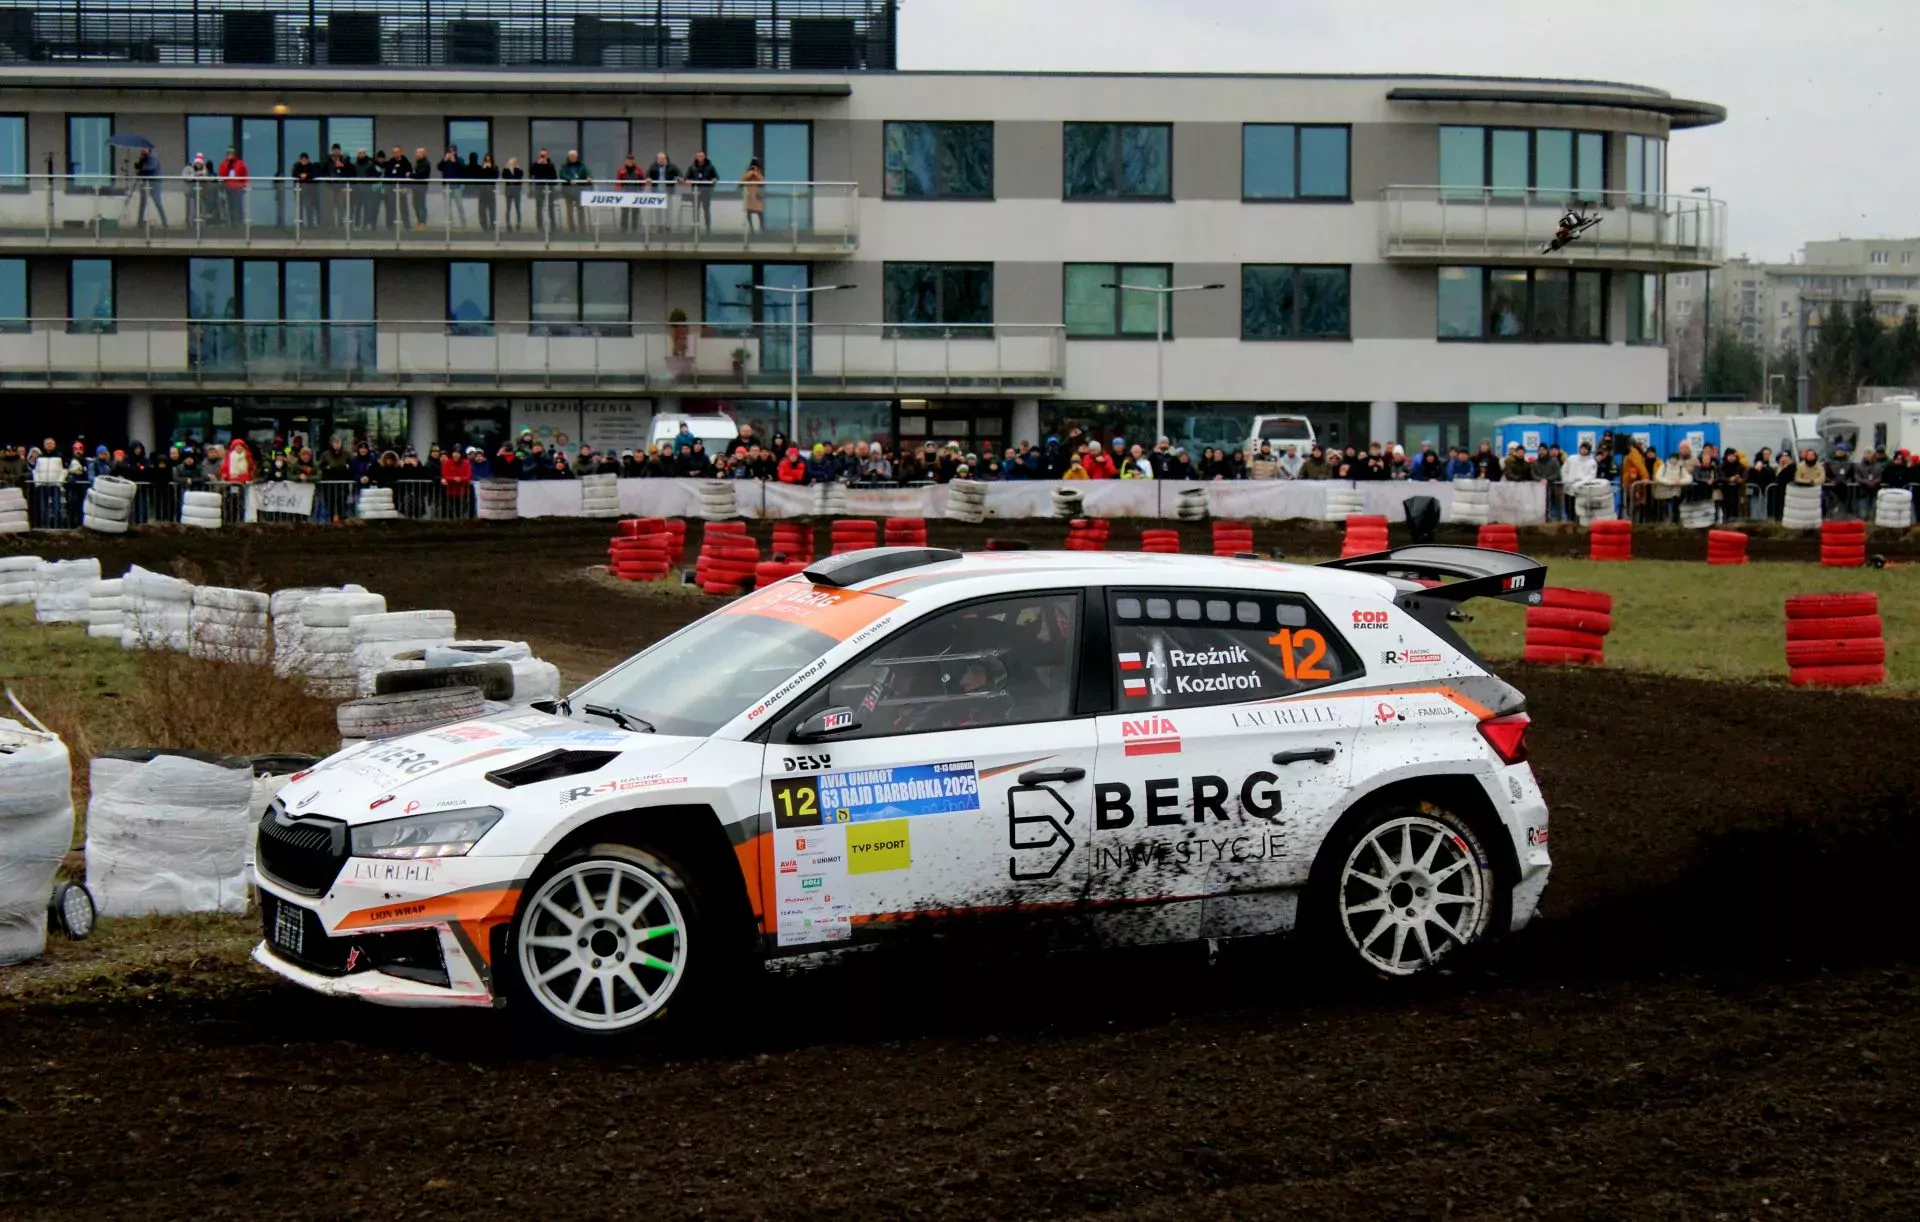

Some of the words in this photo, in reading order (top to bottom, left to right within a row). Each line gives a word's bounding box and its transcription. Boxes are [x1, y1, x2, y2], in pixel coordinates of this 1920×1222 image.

[590, 195, 623, 204] JURY
[632, 196, 664, 205] JURY
[1352, 610, 1388, 624] top
[1145, 652, 1165, 669] A.
[1170, 645, 1250, 668] Rzeźnik
[1267, 628, 1331, 680] 12
[1150, 678, 1171, 696] K.
[1176, 670, 1262, 694] Kozdroń
[821, 775, 846, 789] AVIA
[849, 769, 893, 786] UNIMOT
[778, 788, 817, 817] 12
[822, 789, 841, 809] 63
[842, 785, 873, 807] RAJD
[875, 778, 943, 804] BARBÓRKA
[943, 775, 977, 797] 2025
[1094, 770, 1283, 830] BERG
[852, 843, 871, 854] TVP
[874, 840, 905, 852] SPORT
[1096, 834, 1287, 870] INWESTYCJE
[817, 856, 841, 864] UNIMOT
[394, 905, 426, 918] WRAP
